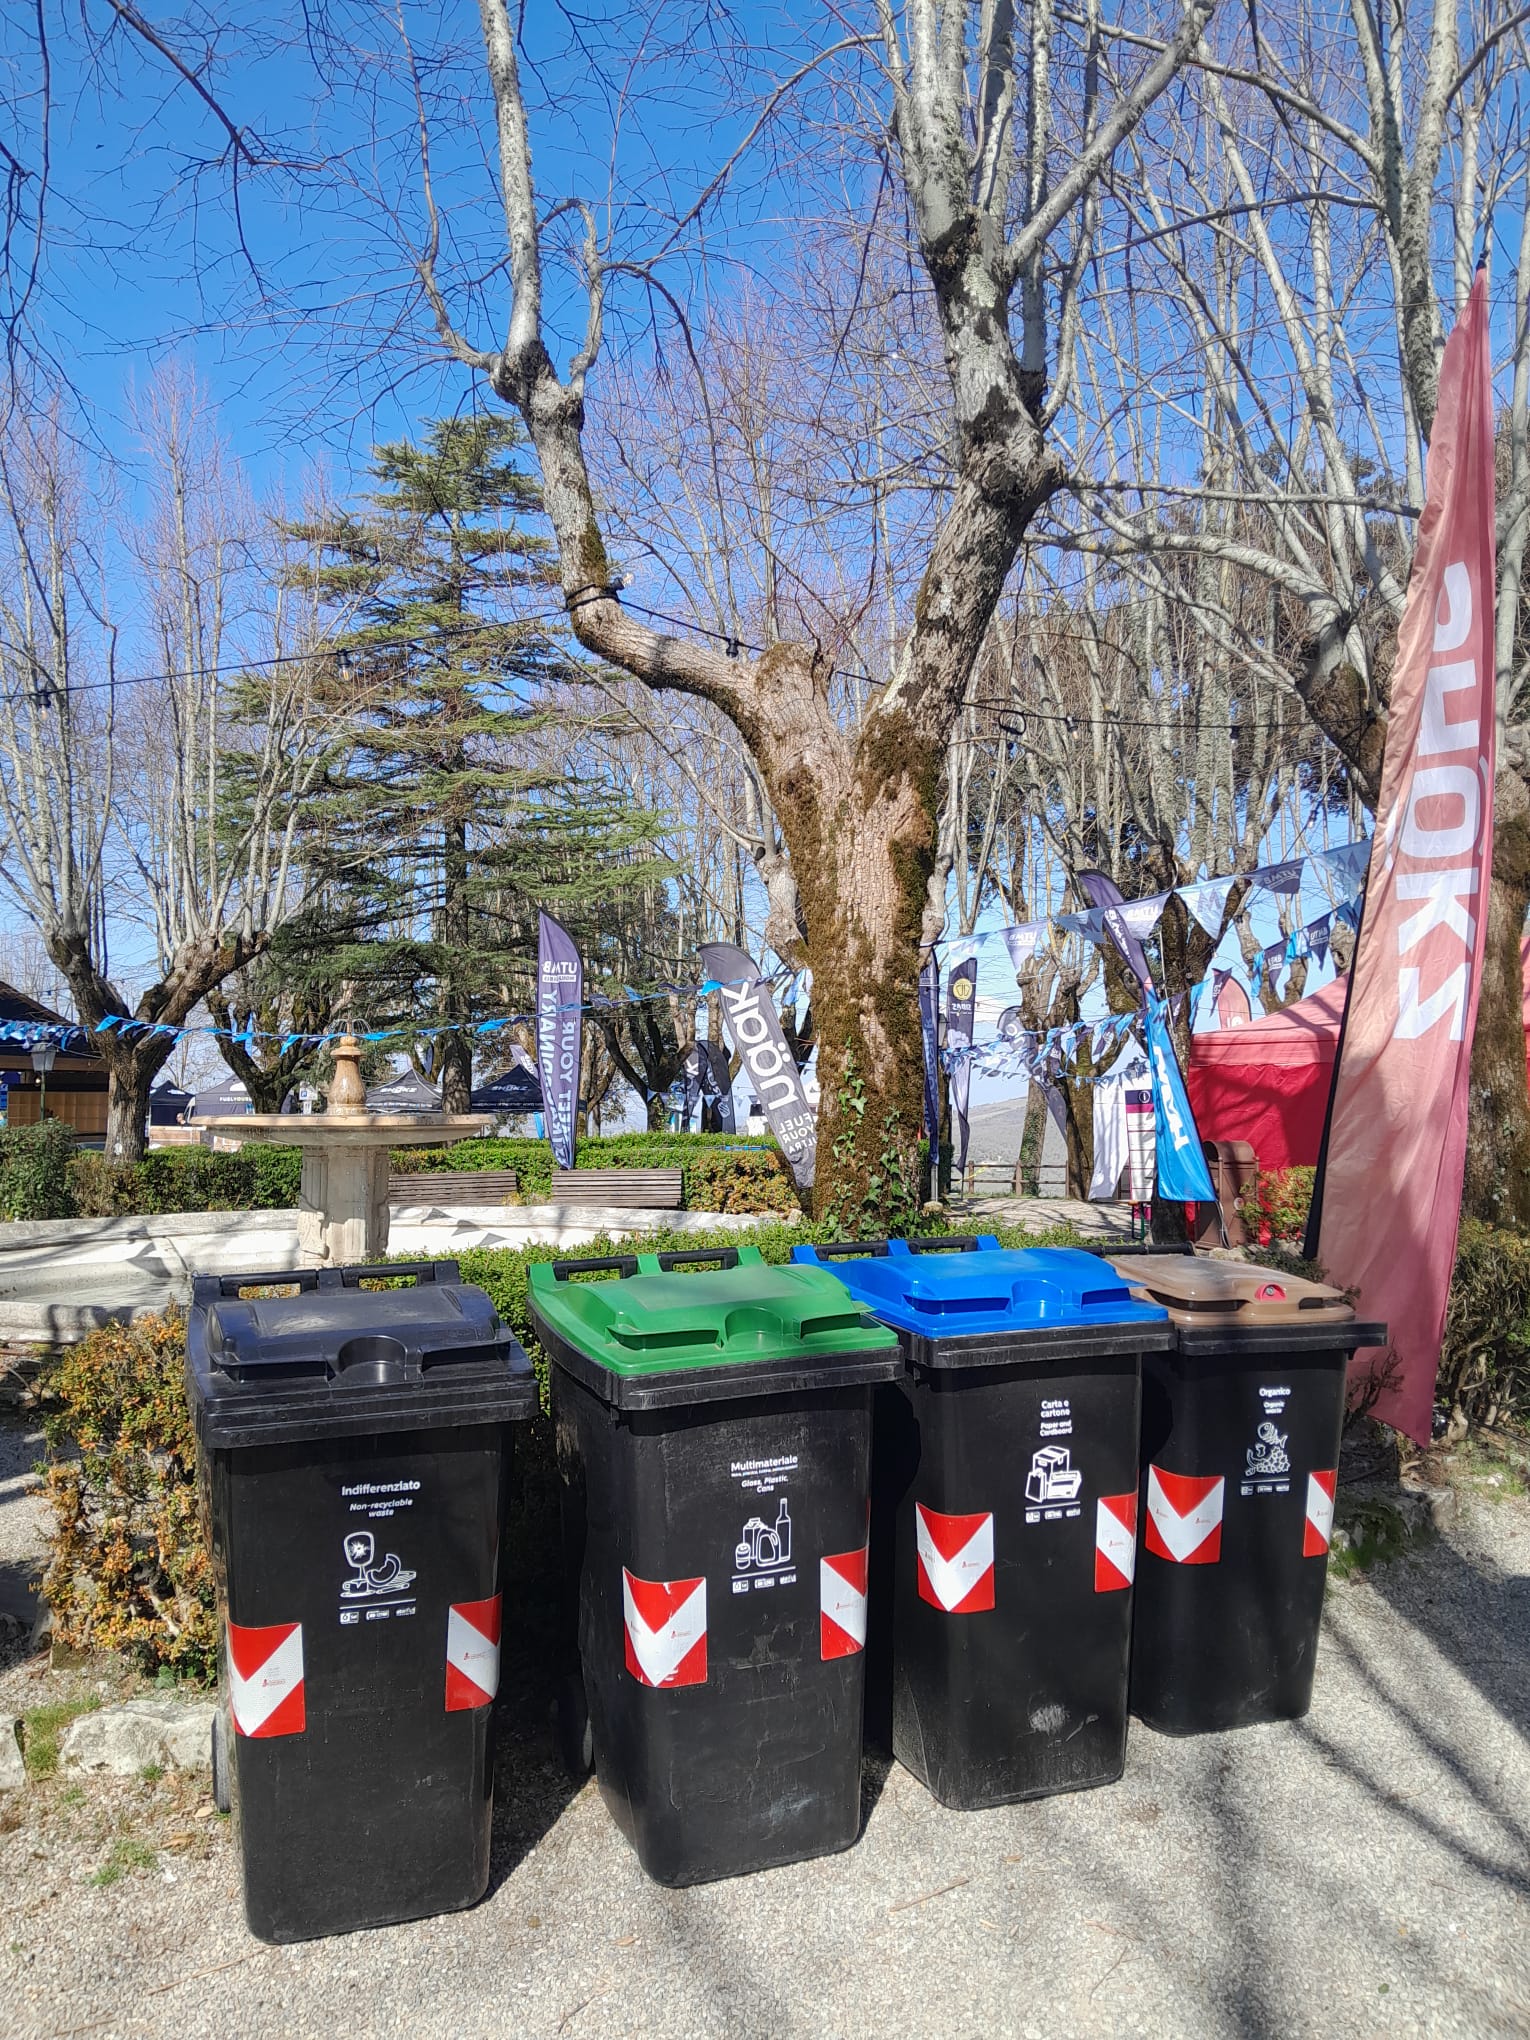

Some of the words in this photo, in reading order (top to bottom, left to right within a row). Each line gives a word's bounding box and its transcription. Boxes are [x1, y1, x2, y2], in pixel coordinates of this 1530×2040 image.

[1259, 1387, 1292, 1398] Organico
[1041, 1400, 1063, 1410] Carta
[1063, 1400, 1070, 1408] e
[1040, 1408, 1071, 1418] cartone
[1040, 1421, 1059, 1431] Paper
[731, 1454, 799, 1473] Multimateriale
[341, 1480, 421, 1496] Indifferenziato
[756, 1485, 775, 1494] Cans
[349, 1497, 414, 1512] Non-recyclable
[368, 1508, 395, 1518] waste
